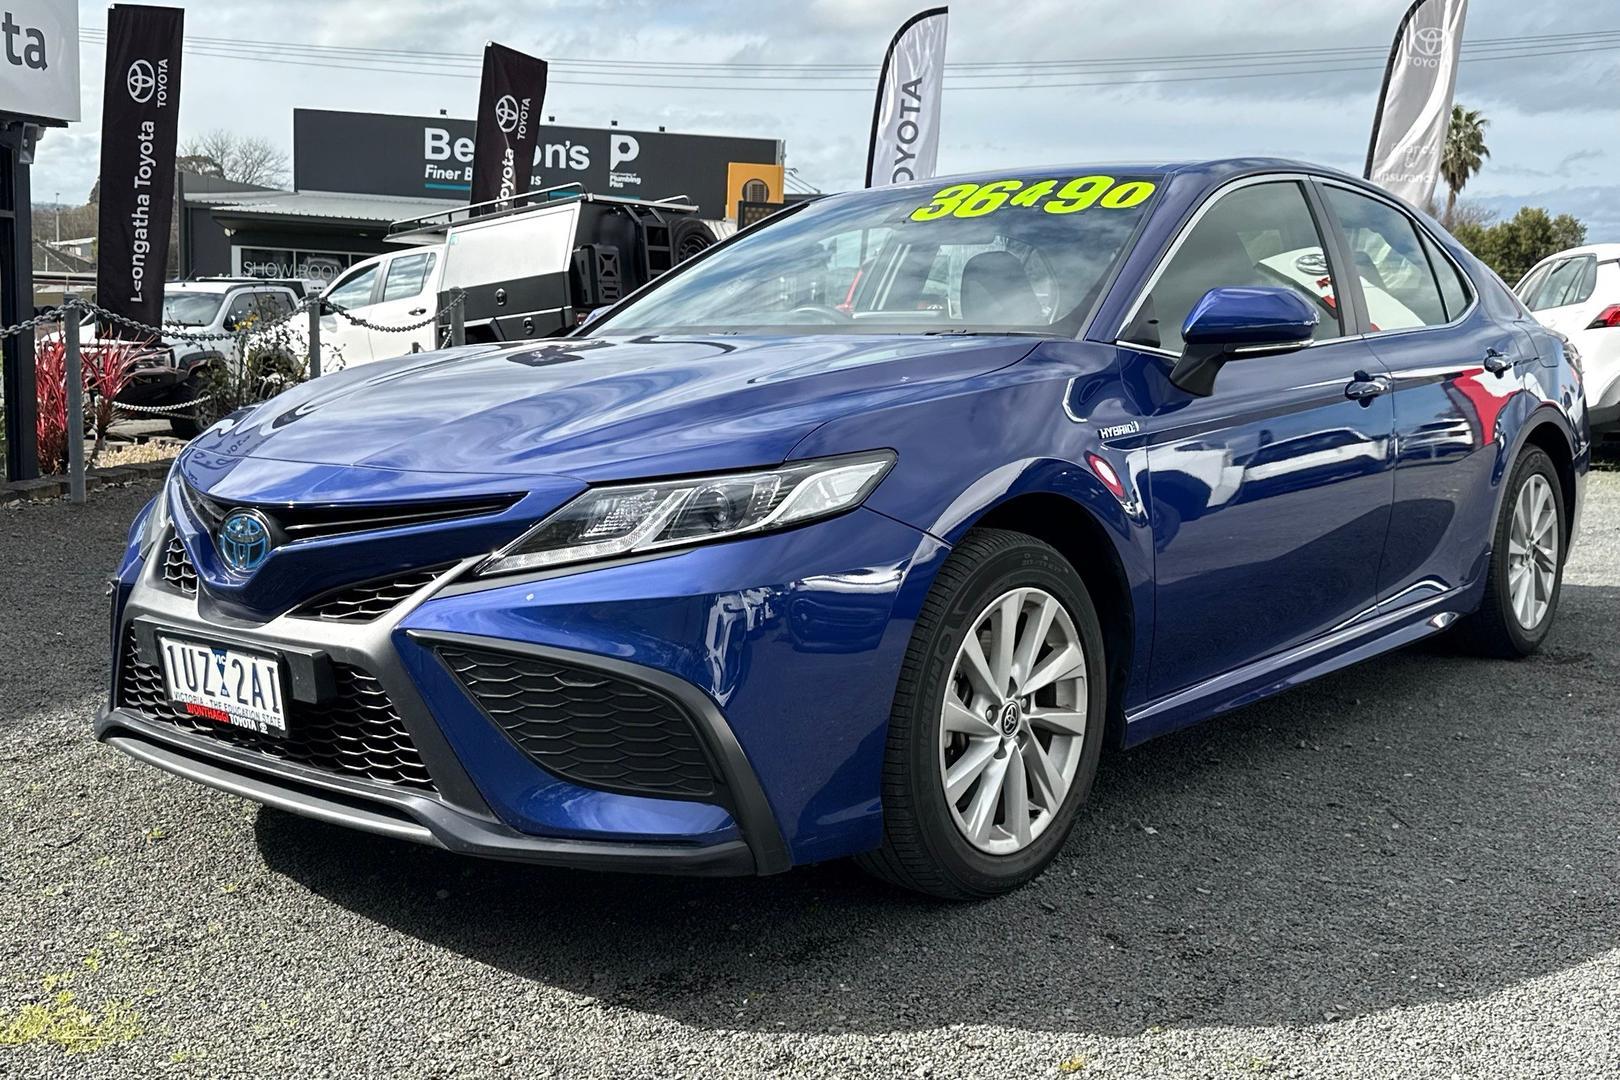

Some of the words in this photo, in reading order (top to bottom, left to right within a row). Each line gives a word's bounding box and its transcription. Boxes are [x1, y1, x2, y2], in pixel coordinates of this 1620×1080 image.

[157, 59, 168, 107] TOYOTA
[517, 98, 531, 140] TOYOTA
[892, 77, 922, 183] OYOTA
[134, 121, 156, 188] Toyota
[425, 127, 590, 170] Ben's
[425, 164, 461, 180] Finer
[610, 175, 641, 184] Plumbing
[1374, 173, 1435, 184] nsuranc
[130, 194, 151, 302] Leongatha
[1100, 423, 1134, 438] HYBRID
[215, 654, 227, 665] VIC
[174, 691, 204, 705] VICTORIA
[209, 699, 222, 709] THE
[224, 703, 260, 721] EDUCATION
[261, 713, 282, 728] STATE
[186, 702, 229, 722] WONTHAGGI
[229, 714, 257, 731] TOYOTA
